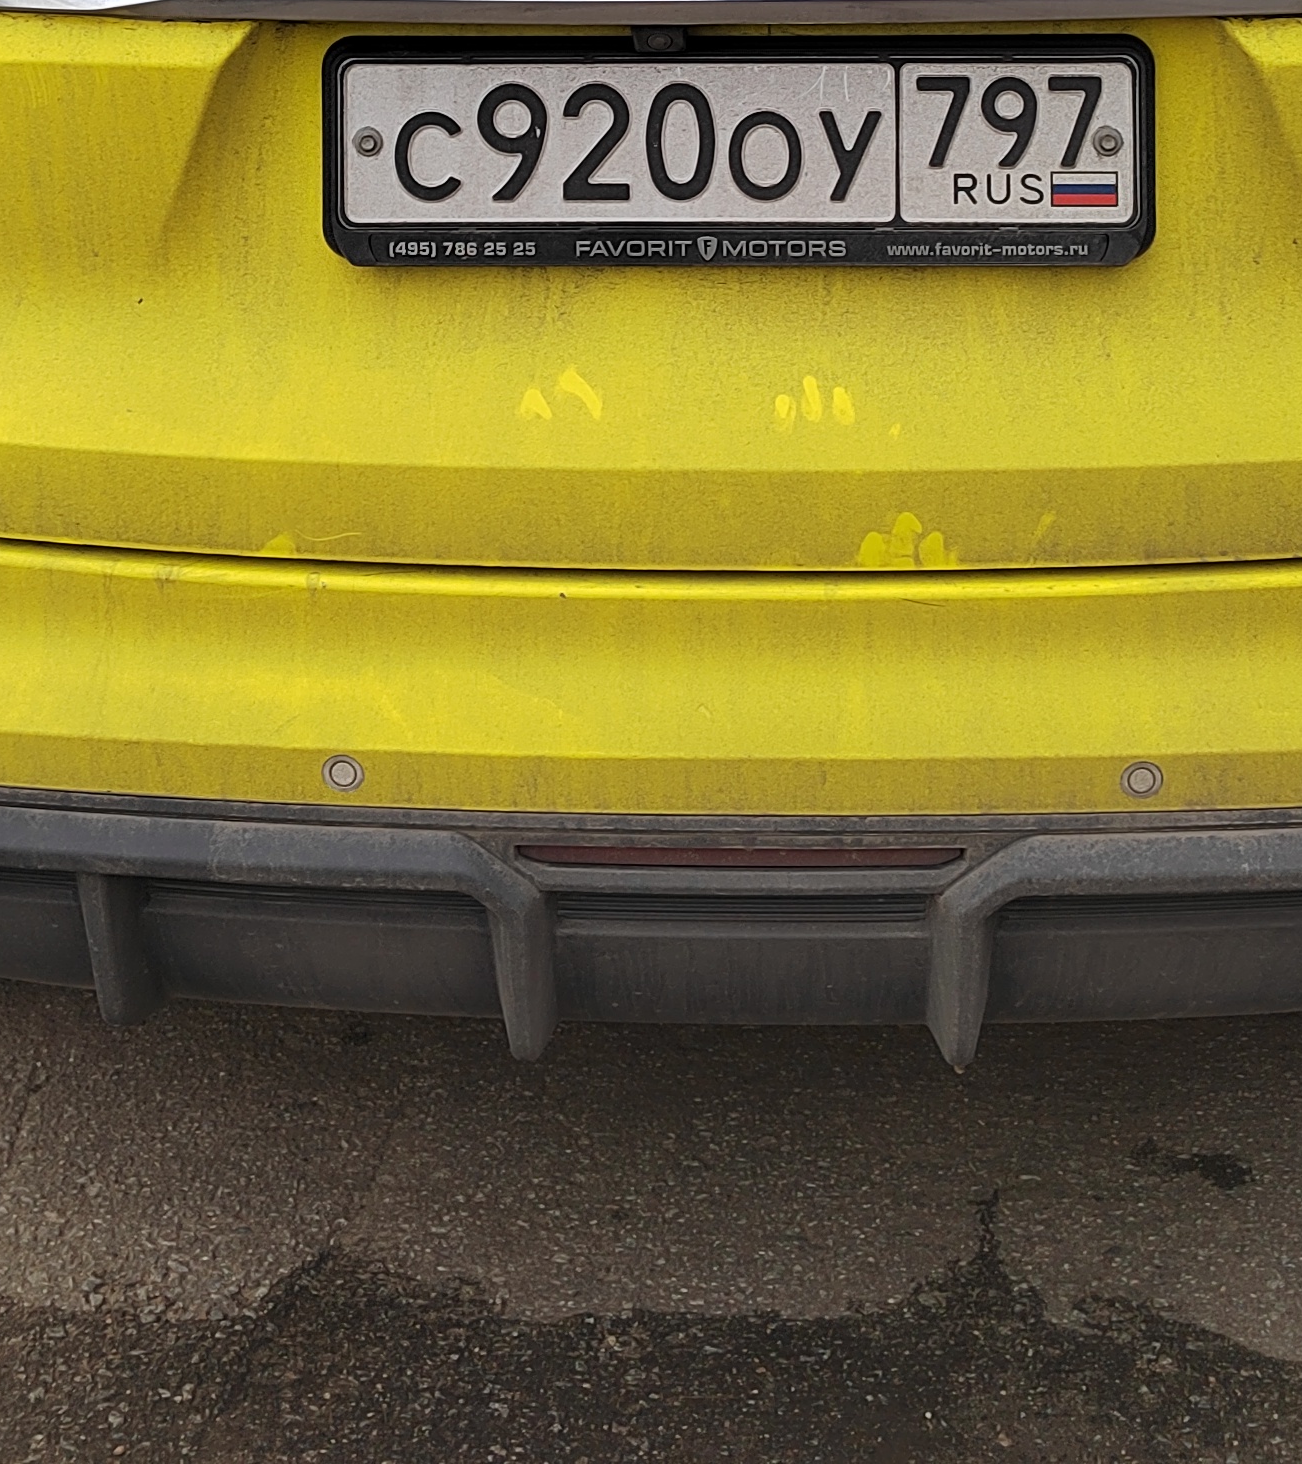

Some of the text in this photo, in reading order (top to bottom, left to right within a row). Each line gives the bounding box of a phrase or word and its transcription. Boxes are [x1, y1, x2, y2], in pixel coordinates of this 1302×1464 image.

[915, 75, 1103, 168] 797
[951, 172, 1044, 206] RUS
[389, 241, 536, 258] (495) 786 25 25
[575, 240, 693, 257] FAVORIT
[722, 240, 847, 257] MOTORS
[886, 242, 1089, 257] www.favorit-motors.ru
